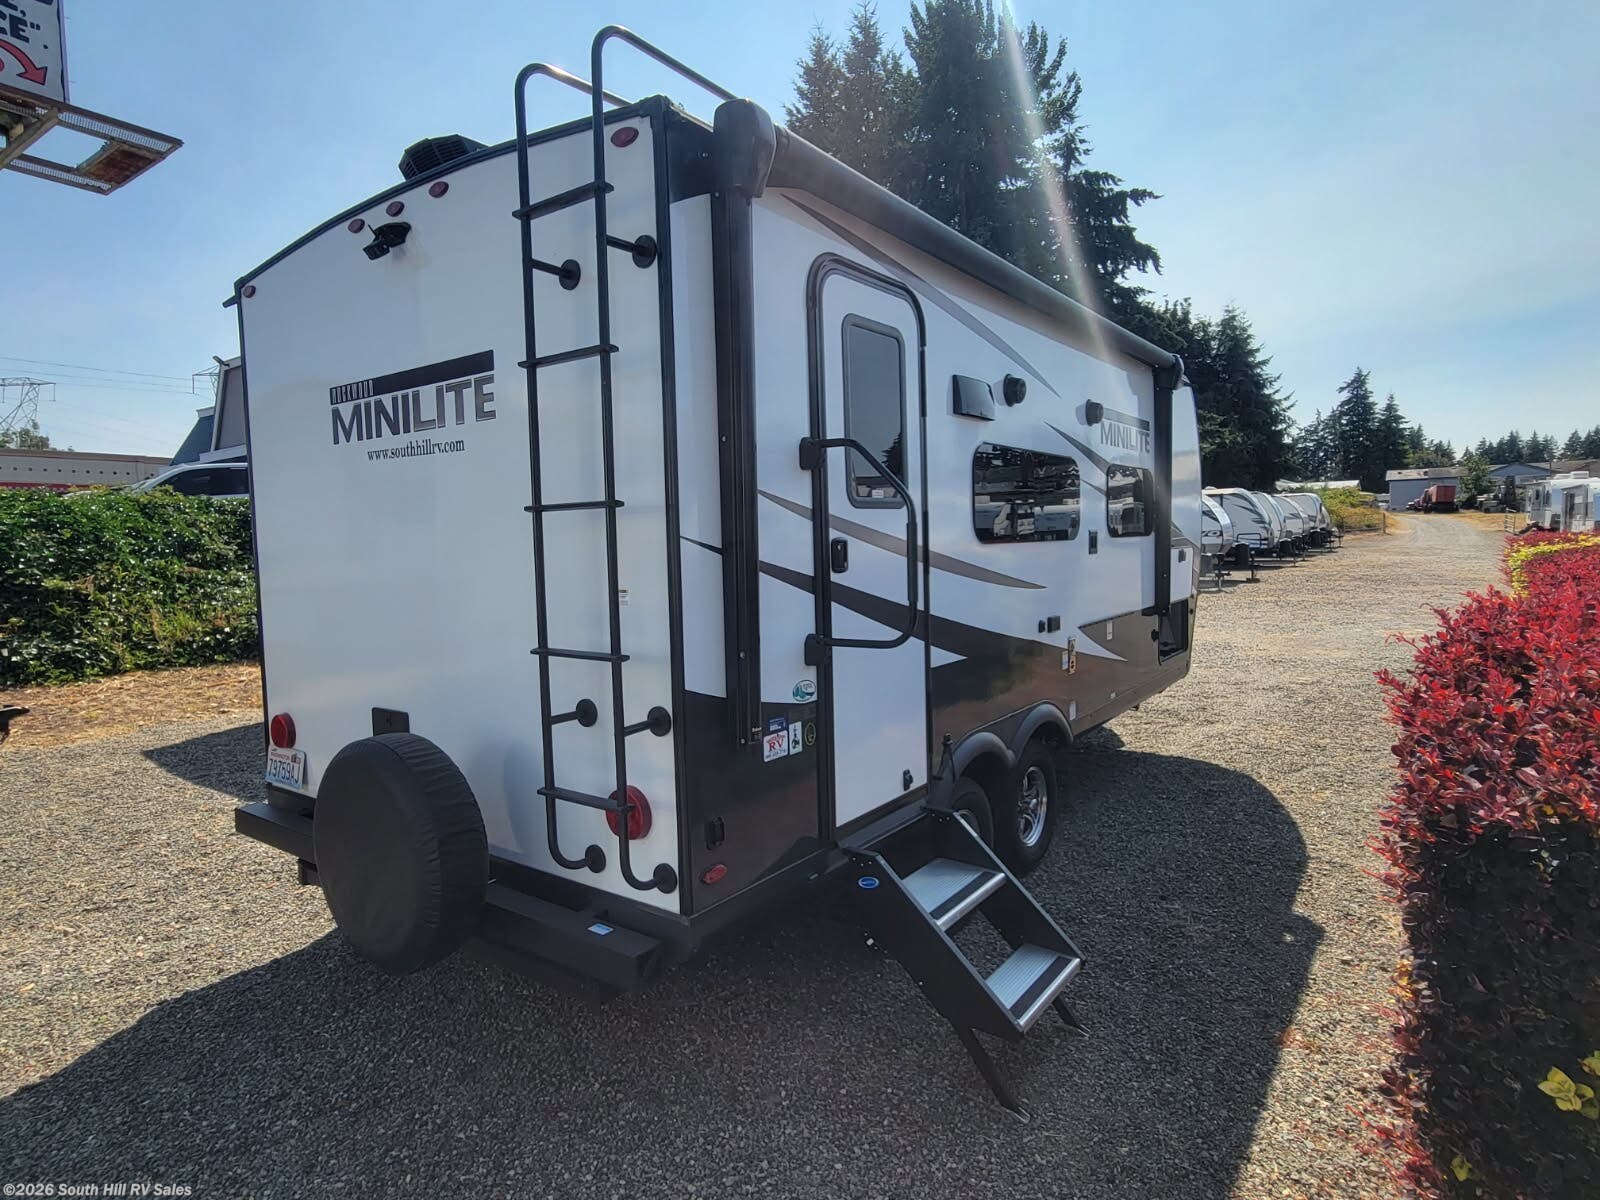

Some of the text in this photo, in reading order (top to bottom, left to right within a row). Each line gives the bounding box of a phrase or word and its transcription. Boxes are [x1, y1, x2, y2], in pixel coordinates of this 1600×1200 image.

[331, 374, 496, 445] MINILITE
[367, 438, 465, 461] www.southhillrv.com
[1100, 421, 1150, 456] MINILITE
